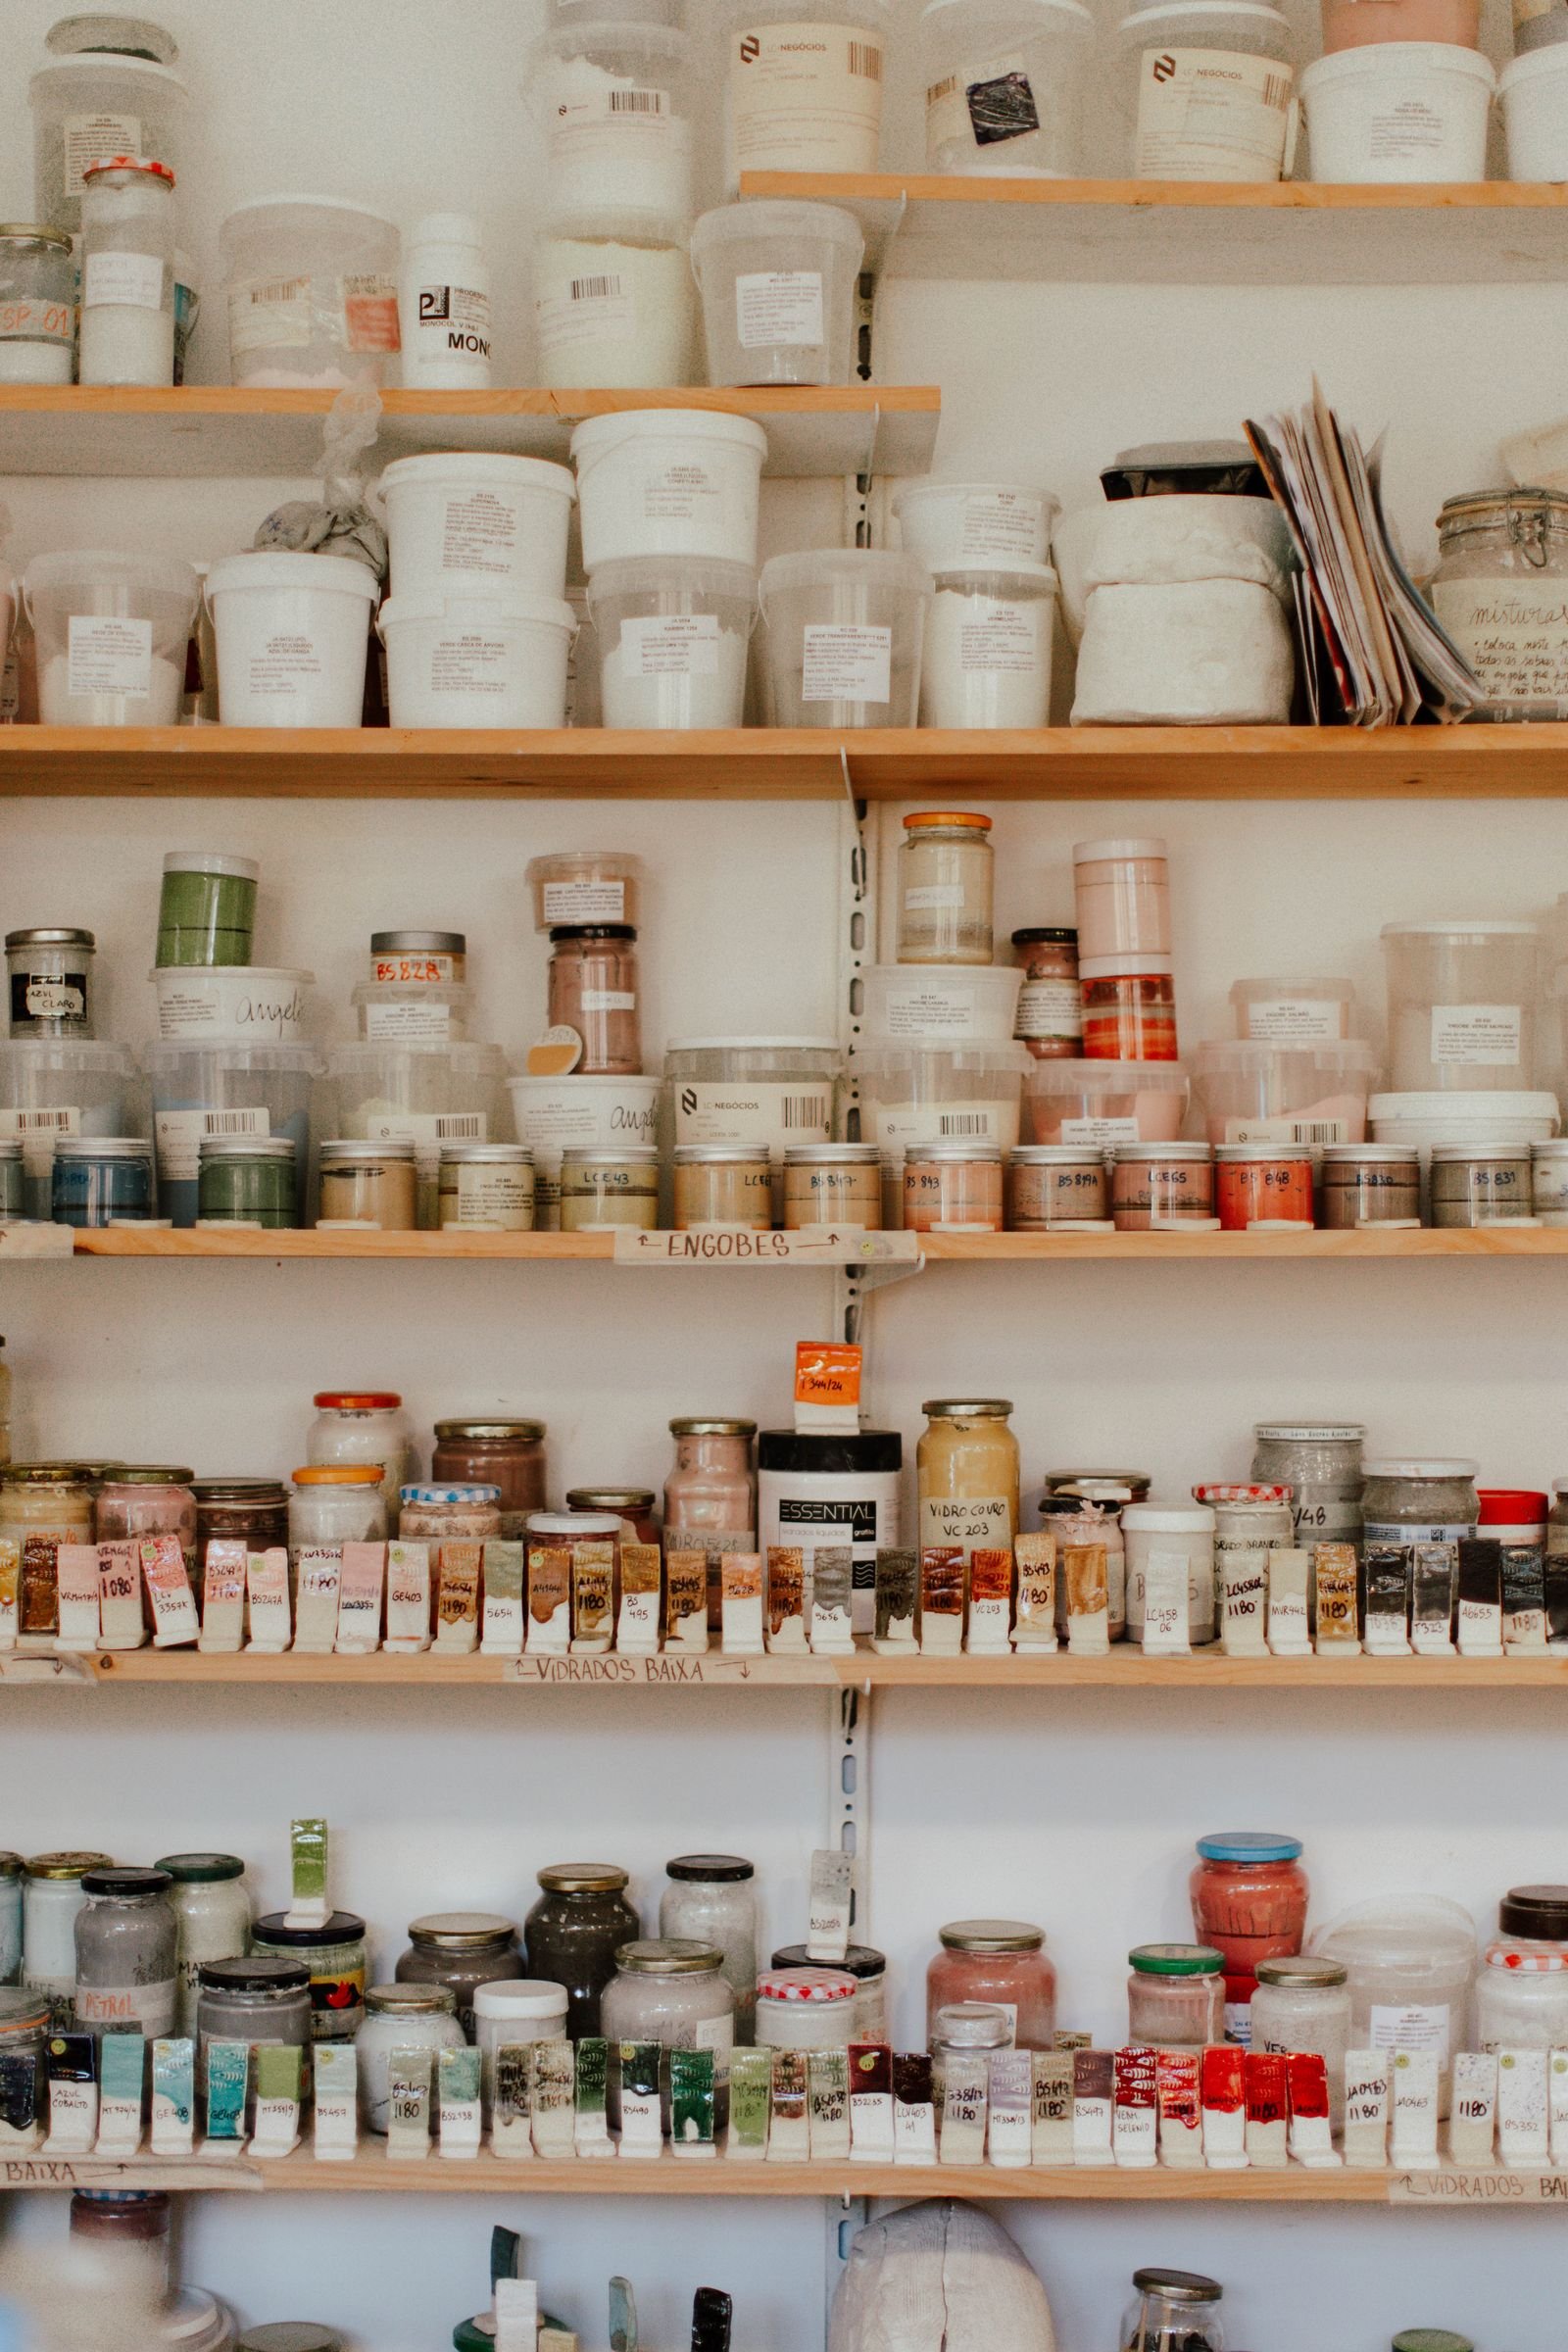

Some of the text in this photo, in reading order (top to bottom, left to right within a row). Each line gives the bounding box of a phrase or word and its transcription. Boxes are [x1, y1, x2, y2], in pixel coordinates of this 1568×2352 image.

[667, 1233, 790, 1257] ENGOBES
[781, 1501, 876, 1520] ESSENTIAL
[943, 1523, 990, 1537] VC 203
[626, 1595, 639, 1606] BS
[629, 1609, 649, 1621] 495
[55, 2088, 81, 2099] AZUL
[52, 2098, 89, 2109] COBALTO
